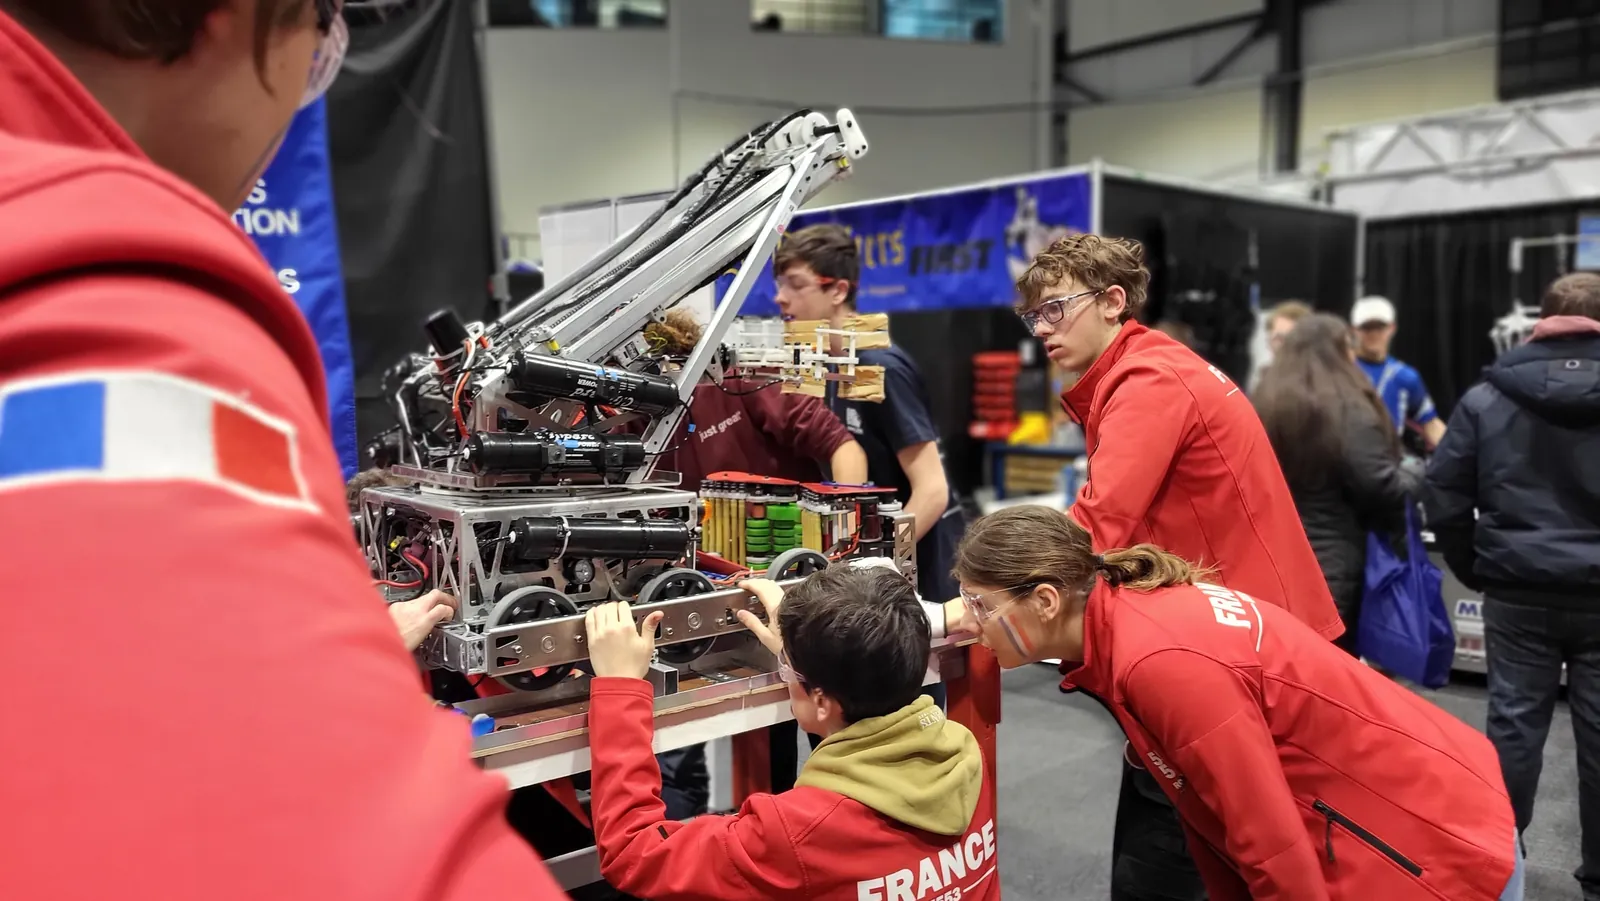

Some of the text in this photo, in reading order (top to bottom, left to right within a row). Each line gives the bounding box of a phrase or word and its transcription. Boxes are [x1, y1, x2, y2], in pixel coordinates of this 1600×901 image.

[698, 410, 742, 443] just great
[857, 818, 996, 901] FRANCE
